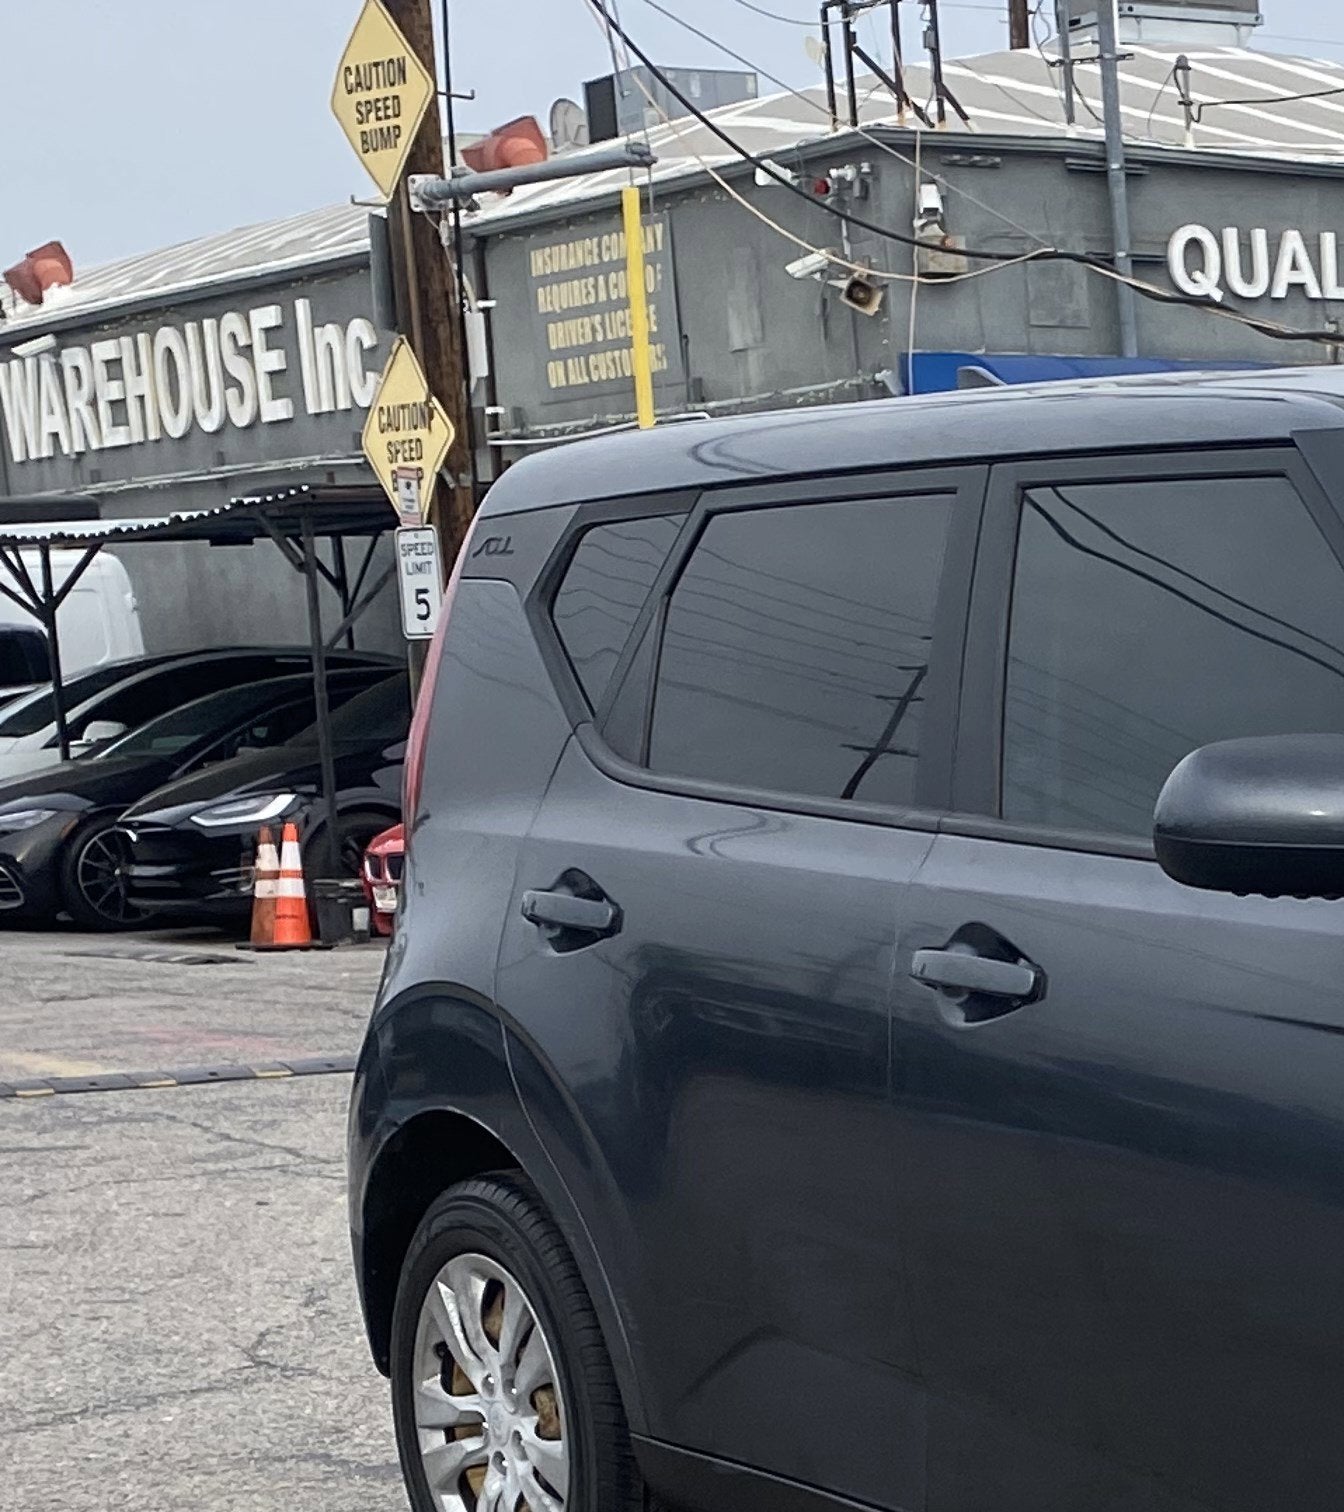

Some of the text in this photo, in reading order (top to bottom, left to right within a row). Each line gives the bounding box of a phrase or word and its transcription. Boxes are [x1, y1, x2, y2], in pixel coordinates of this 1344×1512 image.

[344, 56, 407, 95] CAUTION
[355, 95, 401, 125] SPEED
[360, 124, 402, 154] BUMP
[530, 222, 664, 277] INSURANCE COMANY
[537, 276, 596, 314] REQUIRES
[597, 274, 608, 301] A
[547, 304, 658, 350] DRIVER'S LICEE
[547, 343, 668, 388] ON ALL CUSTORS
[0, 304, 294, 463] WAREHOUSE
[378, 401, 429, 434] CAUTION
[386, 438, 423, 464] SPEED
[391, 466, 424, 492] BP
[400, 542, 434, 557] SPEED
[405, 560, 433, 575] LIMIT
[414, 588, 431, 621] 5
